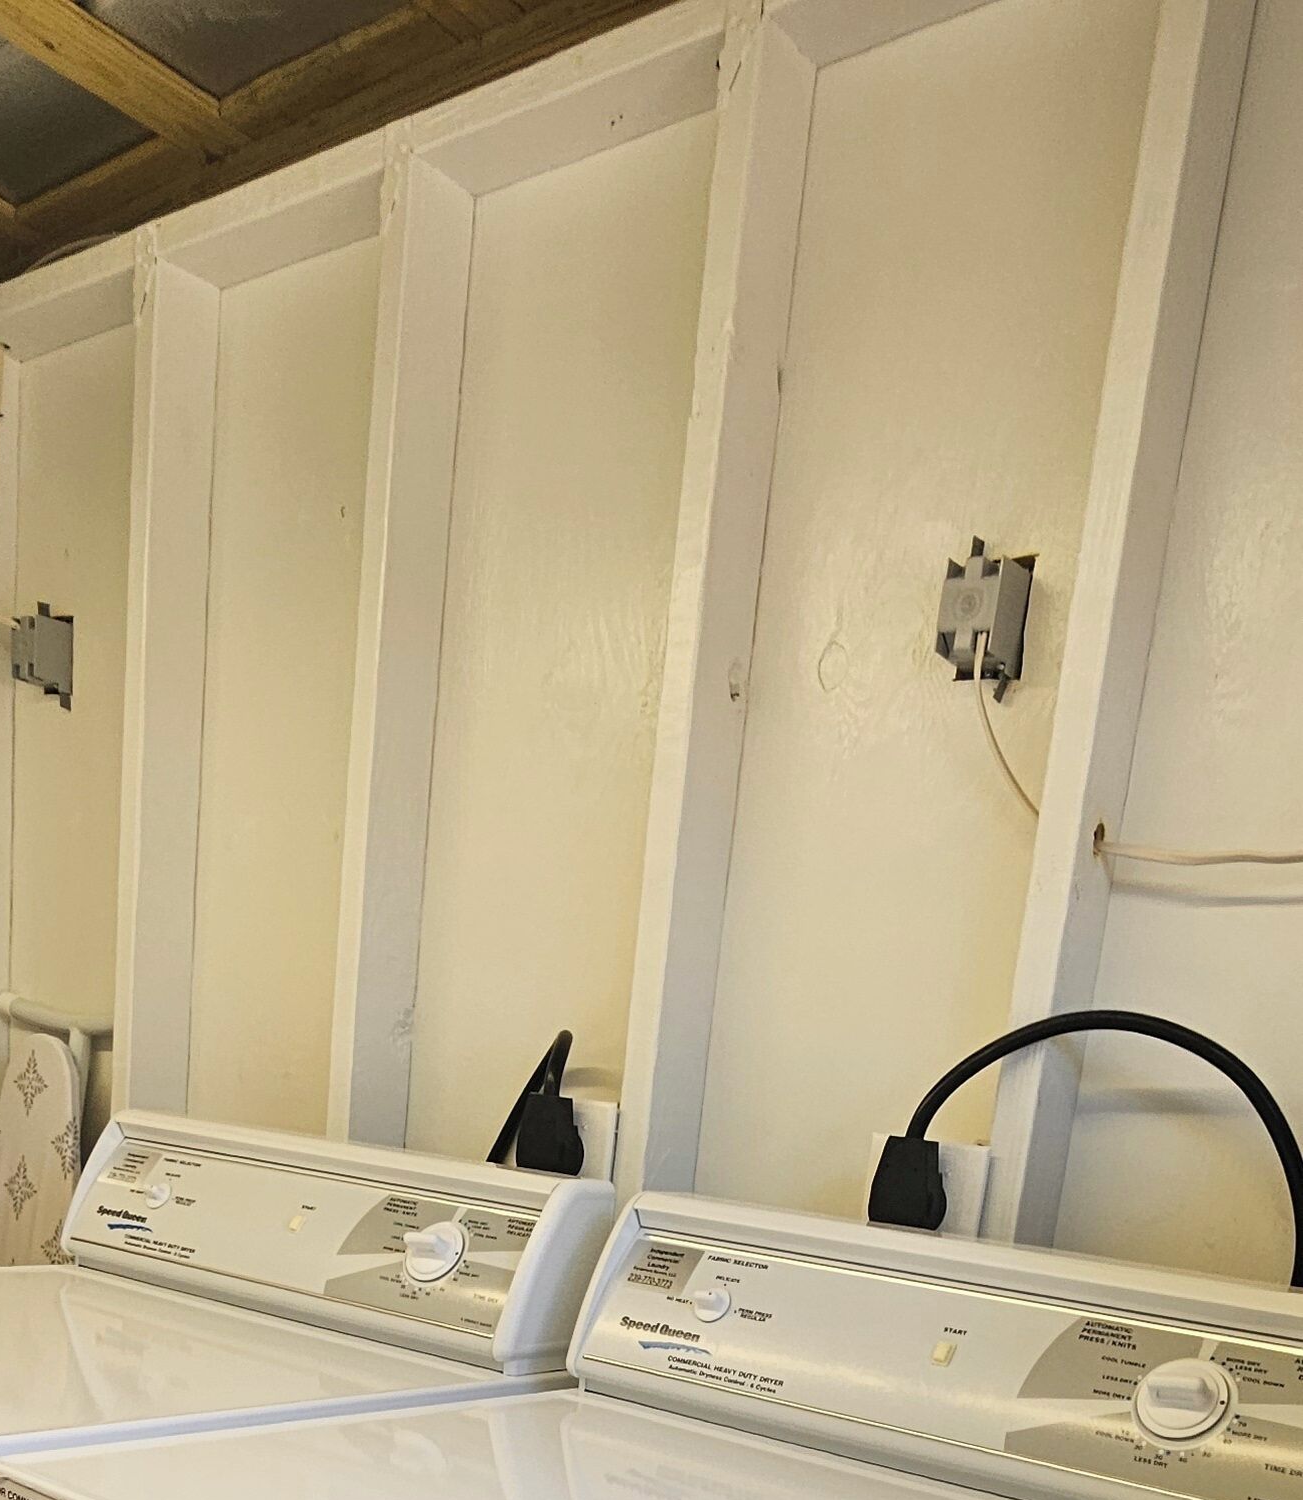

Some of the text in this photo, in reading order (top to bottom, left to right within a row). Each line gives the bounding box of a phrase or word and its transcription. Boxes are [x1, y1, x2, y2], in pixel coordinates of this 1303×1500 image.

[97, 1205, 147, 1223] Speed Queen
[707, 1255, 769, 1270] FABRIC SELECTOR
[620, 1315, 700, 1342] Speed Queen
[943, 1326, 968, 1336] START
[1081, 1327, 1133, 1341] PERMANENT
[1085, 1320, 1134, 1333] AUTOMATIC
[1078, 1334, 1105, 1344] PRESS
[1111, 1340, 1137, 1350] KNITS
[667, 1355, 784, 1386] COMMERCIAL HEAVY DUTY DRYER
[668, 1364, 697, 1375] Automatic
[698, 1370, 722, 1381] Dryness
[1264, 1463, 1286, 1474] TIME
